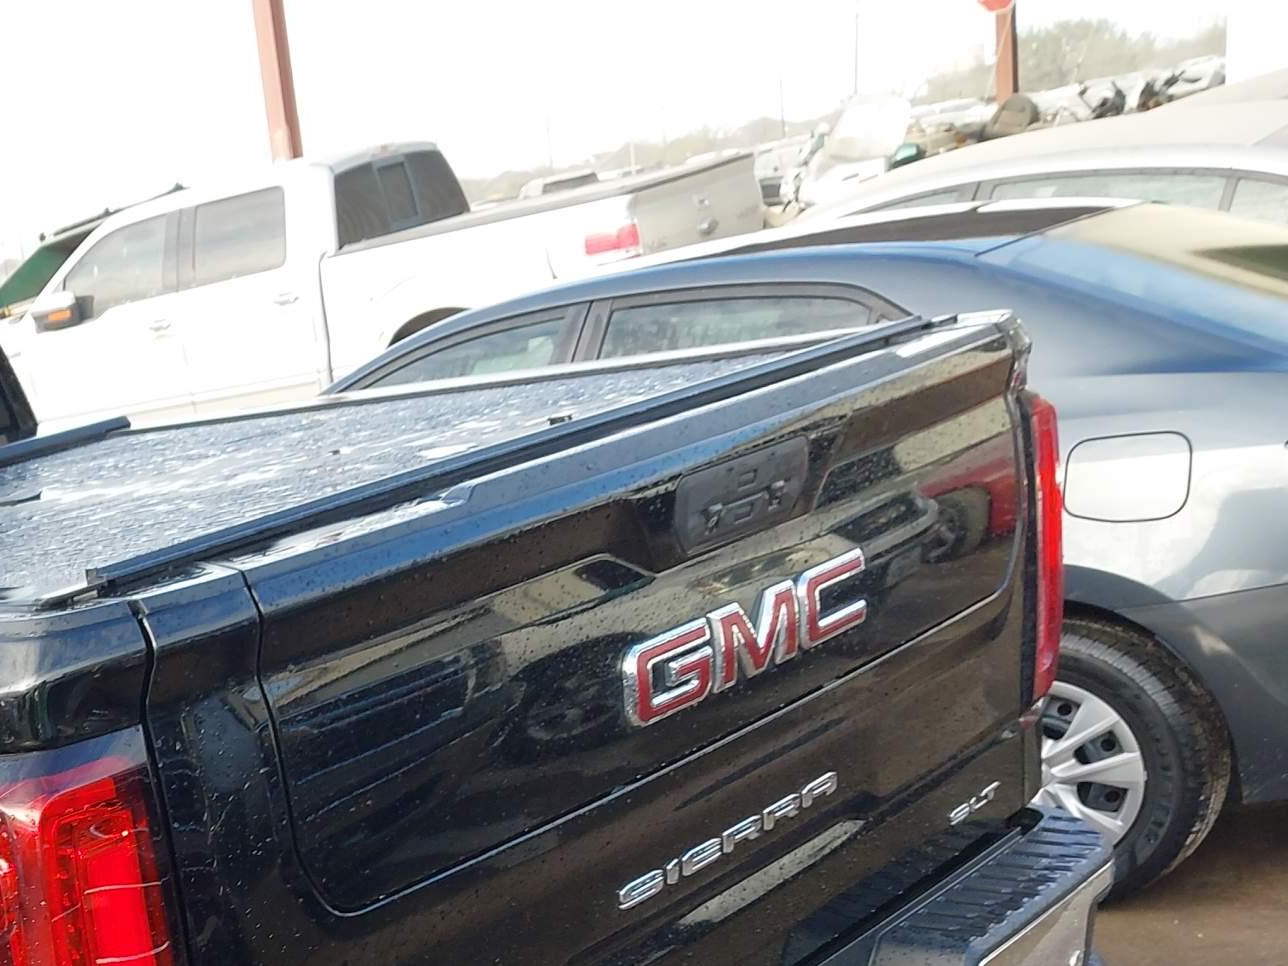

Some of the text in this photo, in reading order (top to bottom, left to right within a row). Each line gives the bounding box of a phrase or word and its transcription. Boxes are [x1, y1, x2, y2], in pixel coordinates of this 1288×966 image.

[622, 548, 867, 727] GMC
[617, 771, 837, 911] SIERRA
[949, 781, 1001, 826] SLT
